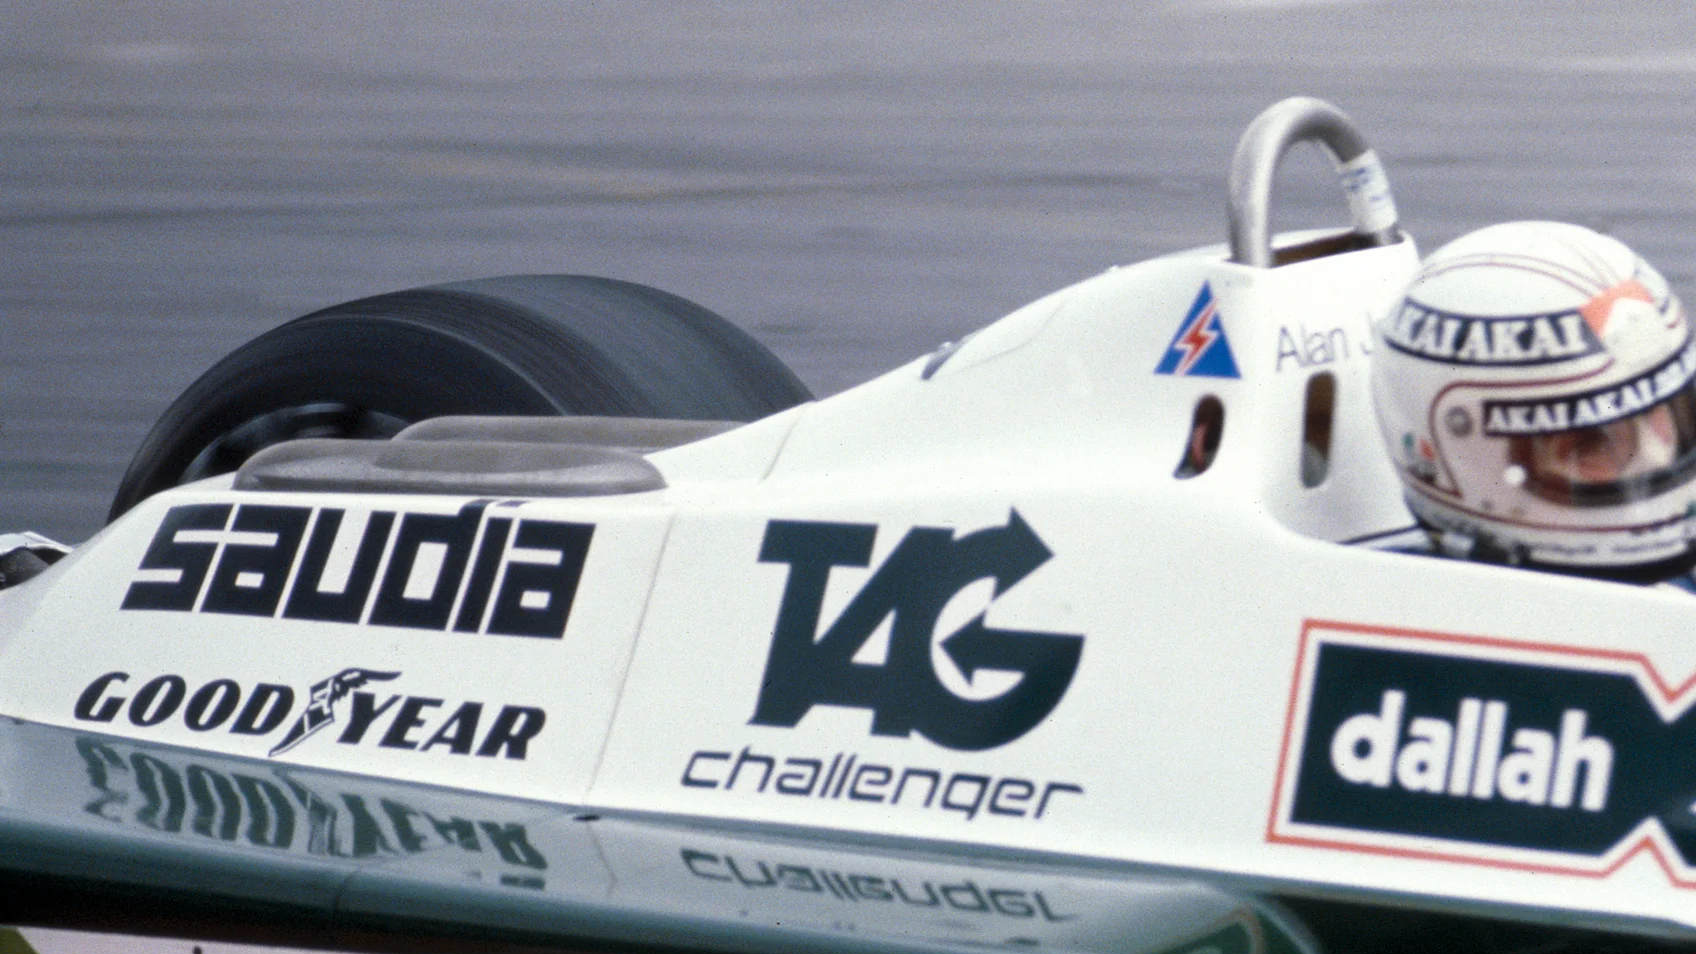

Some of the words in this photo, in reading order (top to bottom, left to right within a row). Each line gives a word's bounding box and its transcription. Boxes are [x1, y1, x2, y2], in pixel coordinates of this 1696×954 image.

[1275, 322, 1349, 374] Alan
[1459, 313, 1590, 361] AKAI
[1484, 401, 1570, 434] AKAI
[747, 506, 1085, 752] TAG
[1330, 689, 1613, 812] dallah
[680, 745, 1085, 821] challenger
